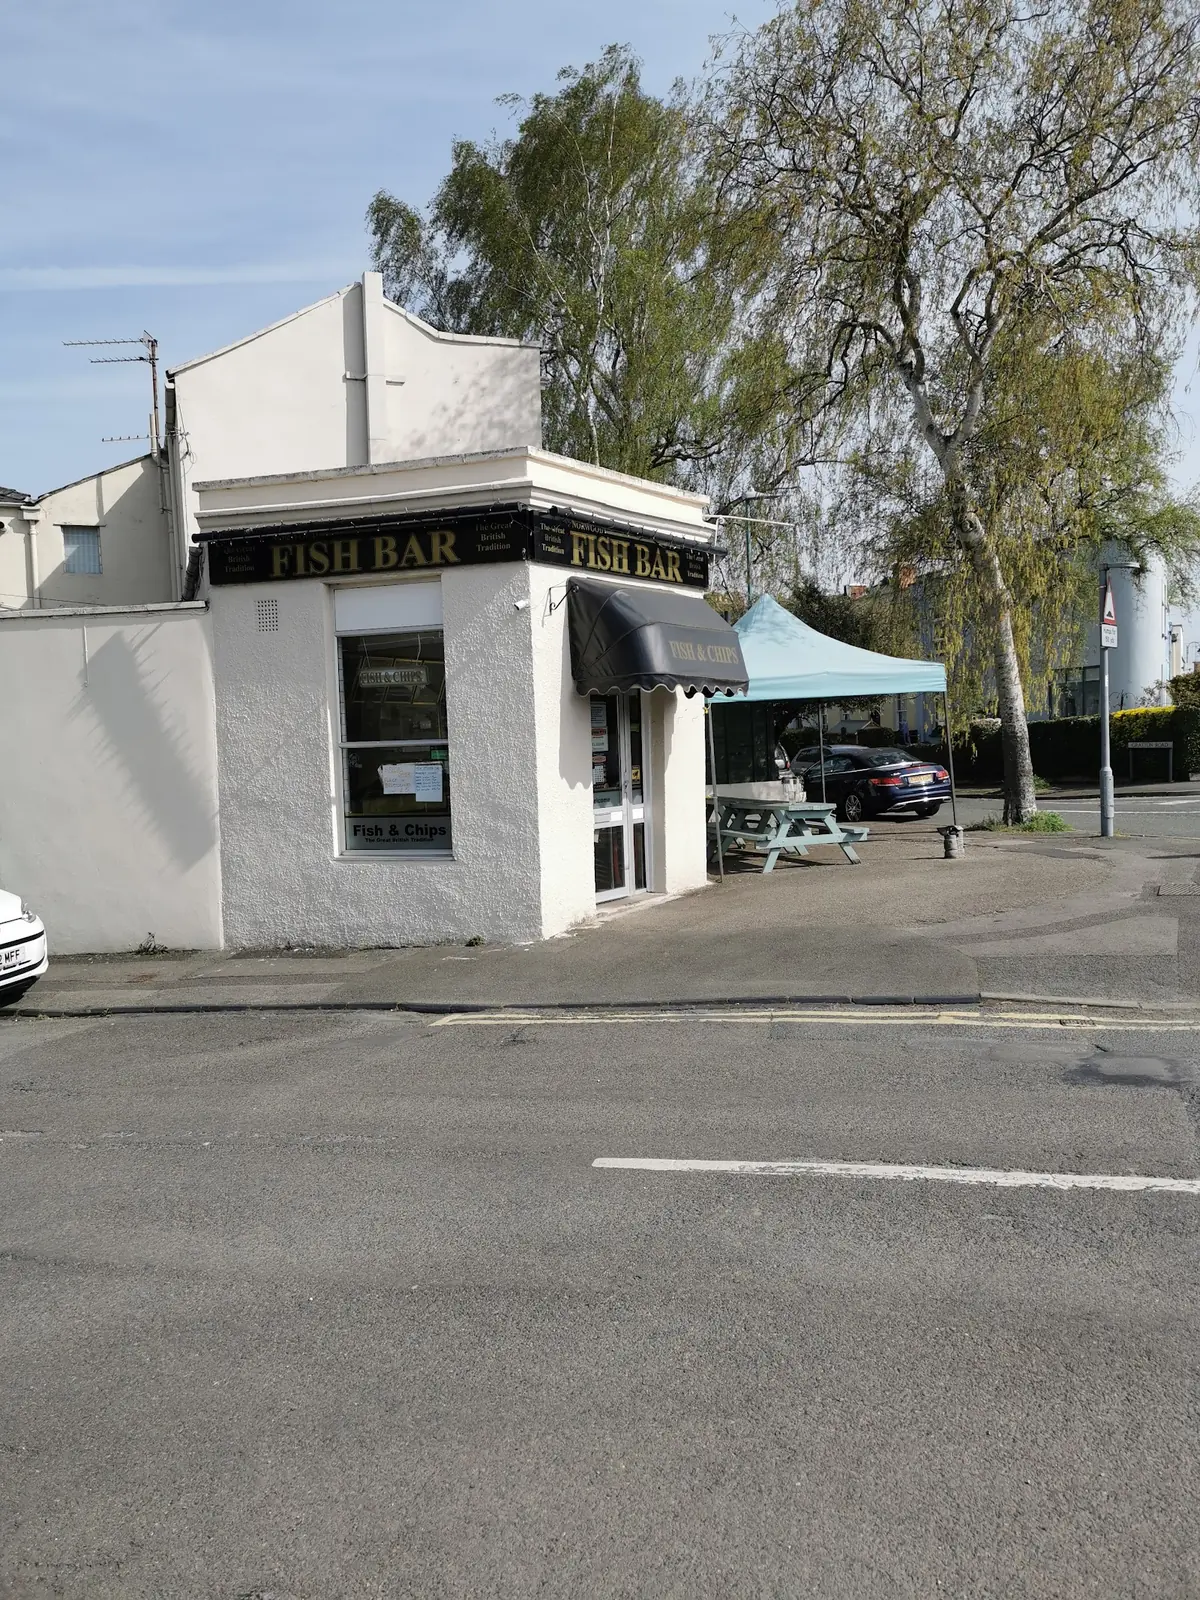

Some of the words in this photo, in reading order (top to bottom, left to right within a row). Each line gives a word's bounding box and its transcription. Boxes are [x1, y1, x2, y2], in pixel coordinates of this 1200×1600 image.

[475, 523, 489, 532] The
[490, 522, 512, 530] Great
[480, 532, 506, 542] British
[475, 542, 511, 552] Tradition
[541, 543, 565, 555] Tradition
[228, 555, 251, 564] British
[270, 535, 363, 579] FISH
[371, 530, 462, 572] BAR
[569, 531, 630, 574] FISH
[634, 543, 683, 583] BAR
[223, 564, 255, 573] Tradition
[668, 640, 697, 661] FISH
[697, 643, 706, 662] &
[706, 645, 740, 665] CHIPS
[360, 671, 382, 684] FISH
[383, 671, 392, 683] &
[392, 670, 423, 683] CHIPS
[353, 824, 383, 837] Fish
[389, 824, 399, 836] &
[404, 823, 447, 838] Chips
[4, 949, 20, 963] MFF
